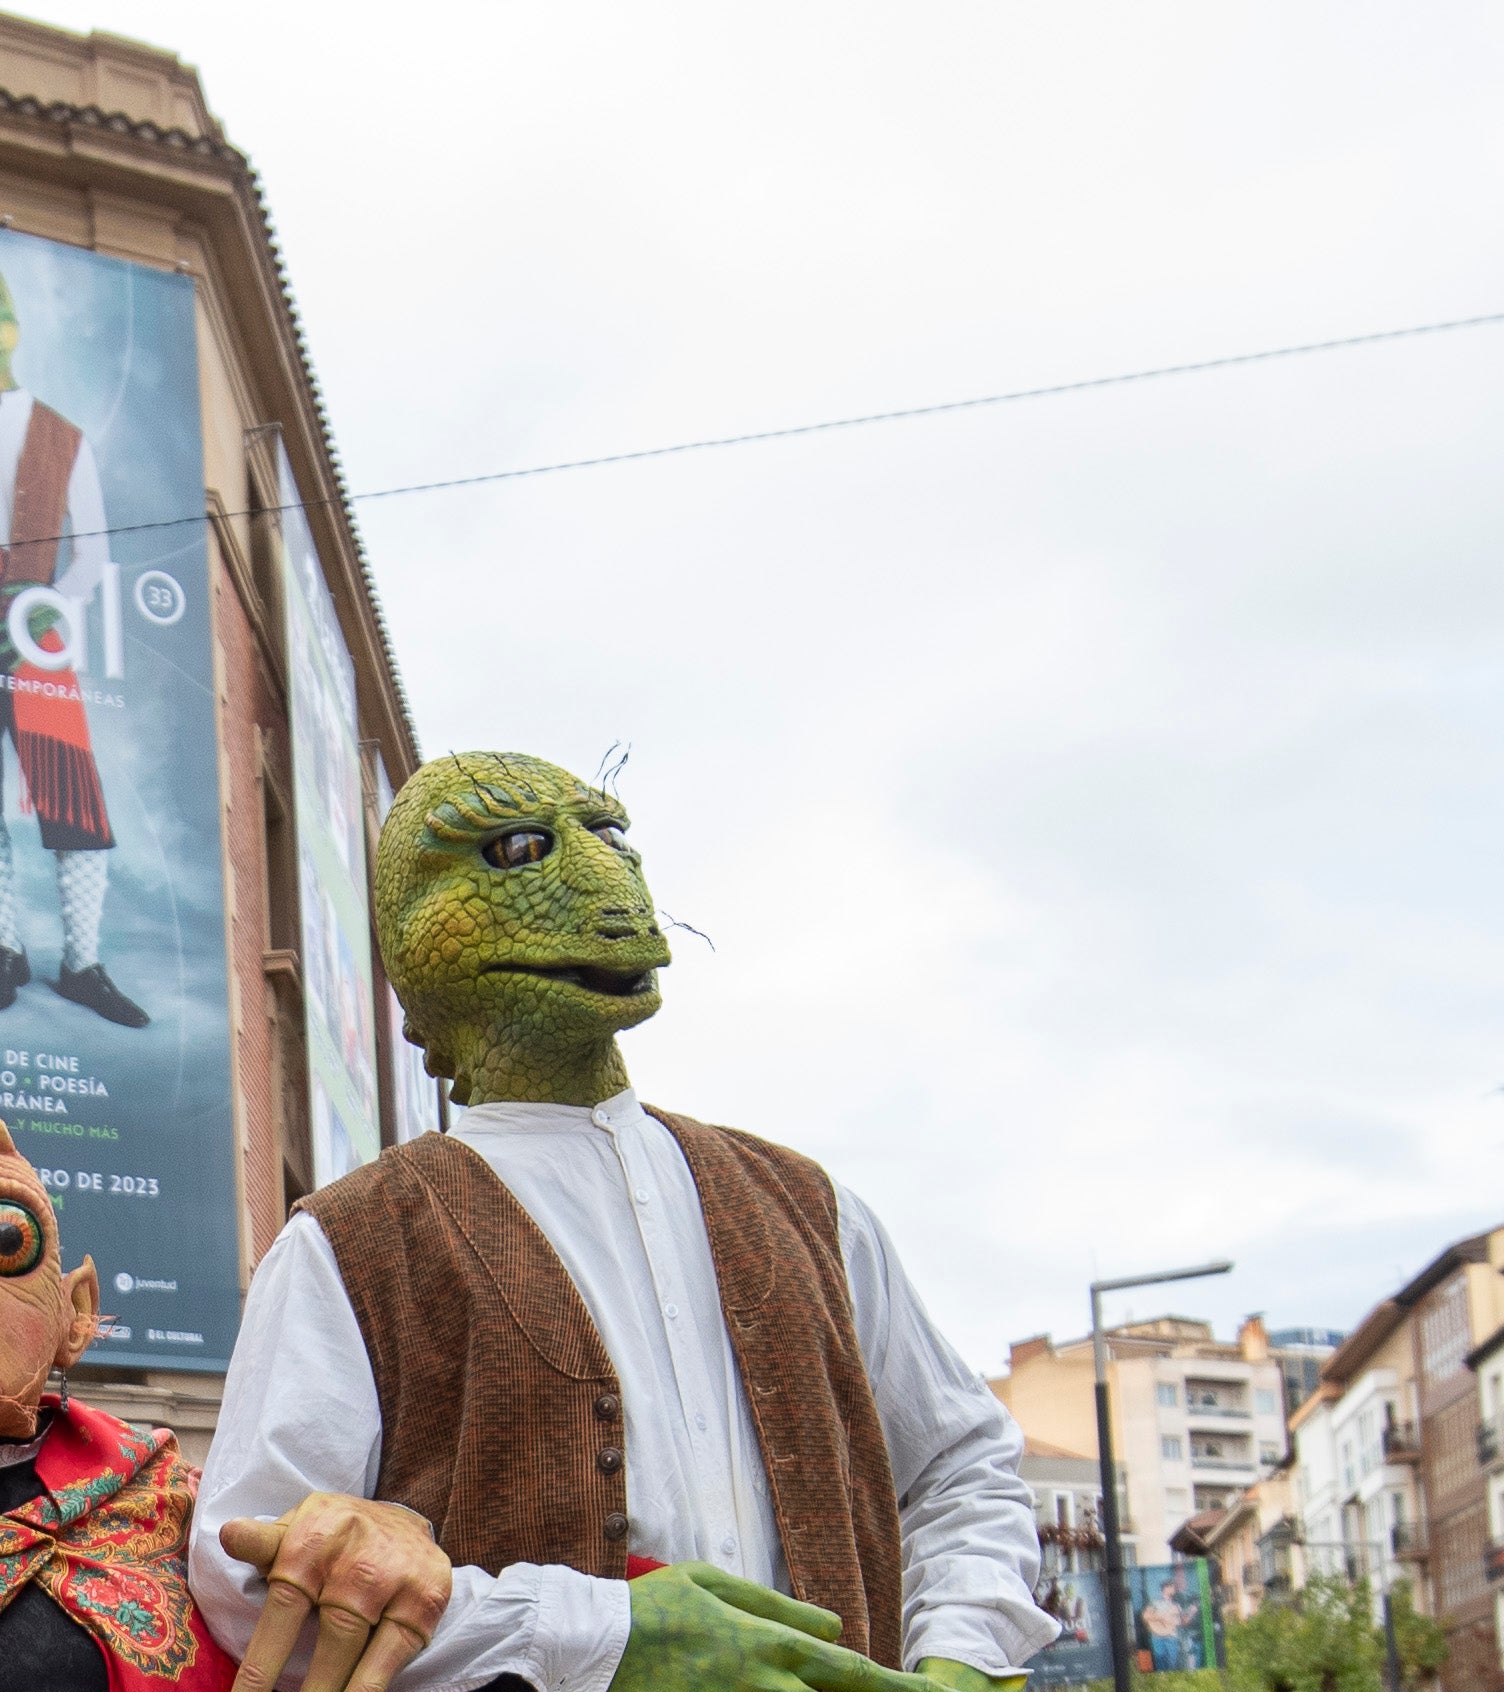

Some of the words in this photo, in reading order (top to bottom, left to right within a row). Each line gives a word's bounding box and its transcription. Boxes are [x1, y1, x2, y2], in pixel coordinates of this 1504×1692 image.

[6, 1049, 29, 1067] DE
[36, 1053, 79, 1072] CINE
[40, 1075, 109, 1097] POESÍA
[31, 1120, 85, 1138] MUCHO
[90, 1124, 120, 1141] MÁS
[77, 1171, 103, 1190] DE
[110, 1174, 160, 1196] 2023
